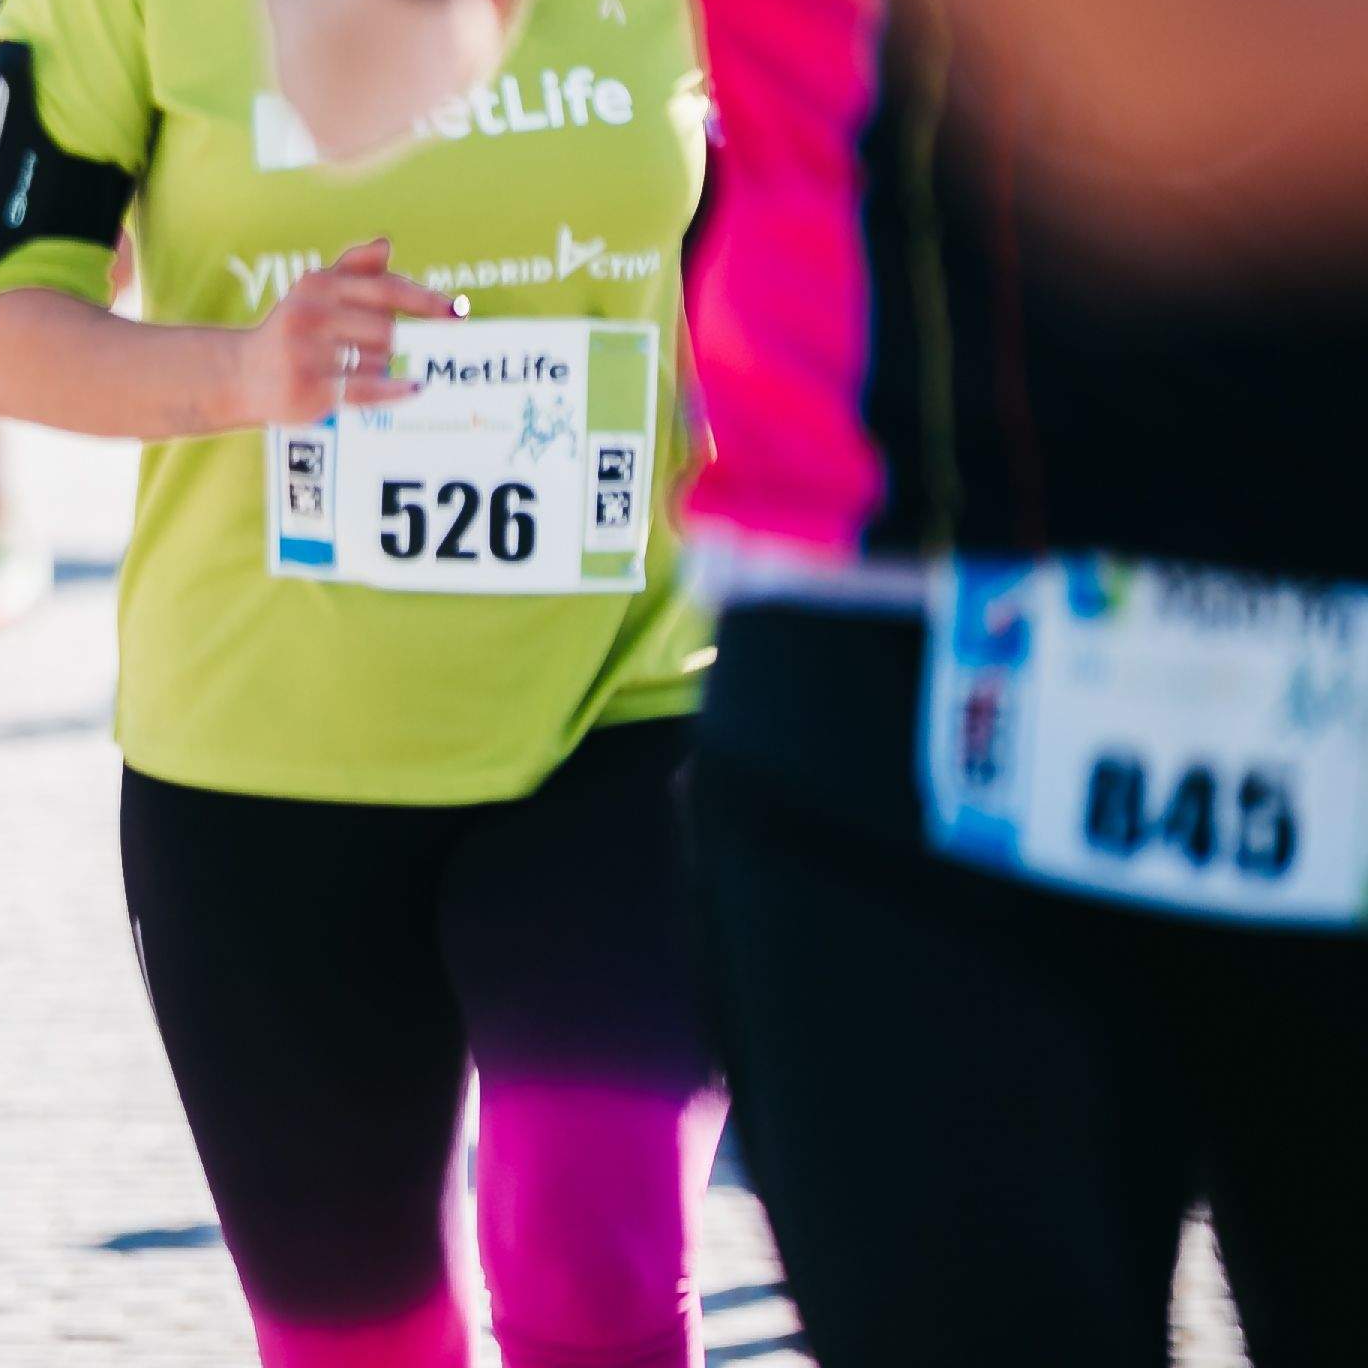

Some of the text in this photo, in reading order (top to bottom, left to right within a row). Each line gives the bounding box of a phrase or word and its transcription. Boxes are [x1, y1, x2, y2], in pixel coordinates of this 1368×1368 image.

[414, 66, 635, 140] etLife
[425, 353, 570, 385] MetLife
[379, 478, 537, 563] 526
